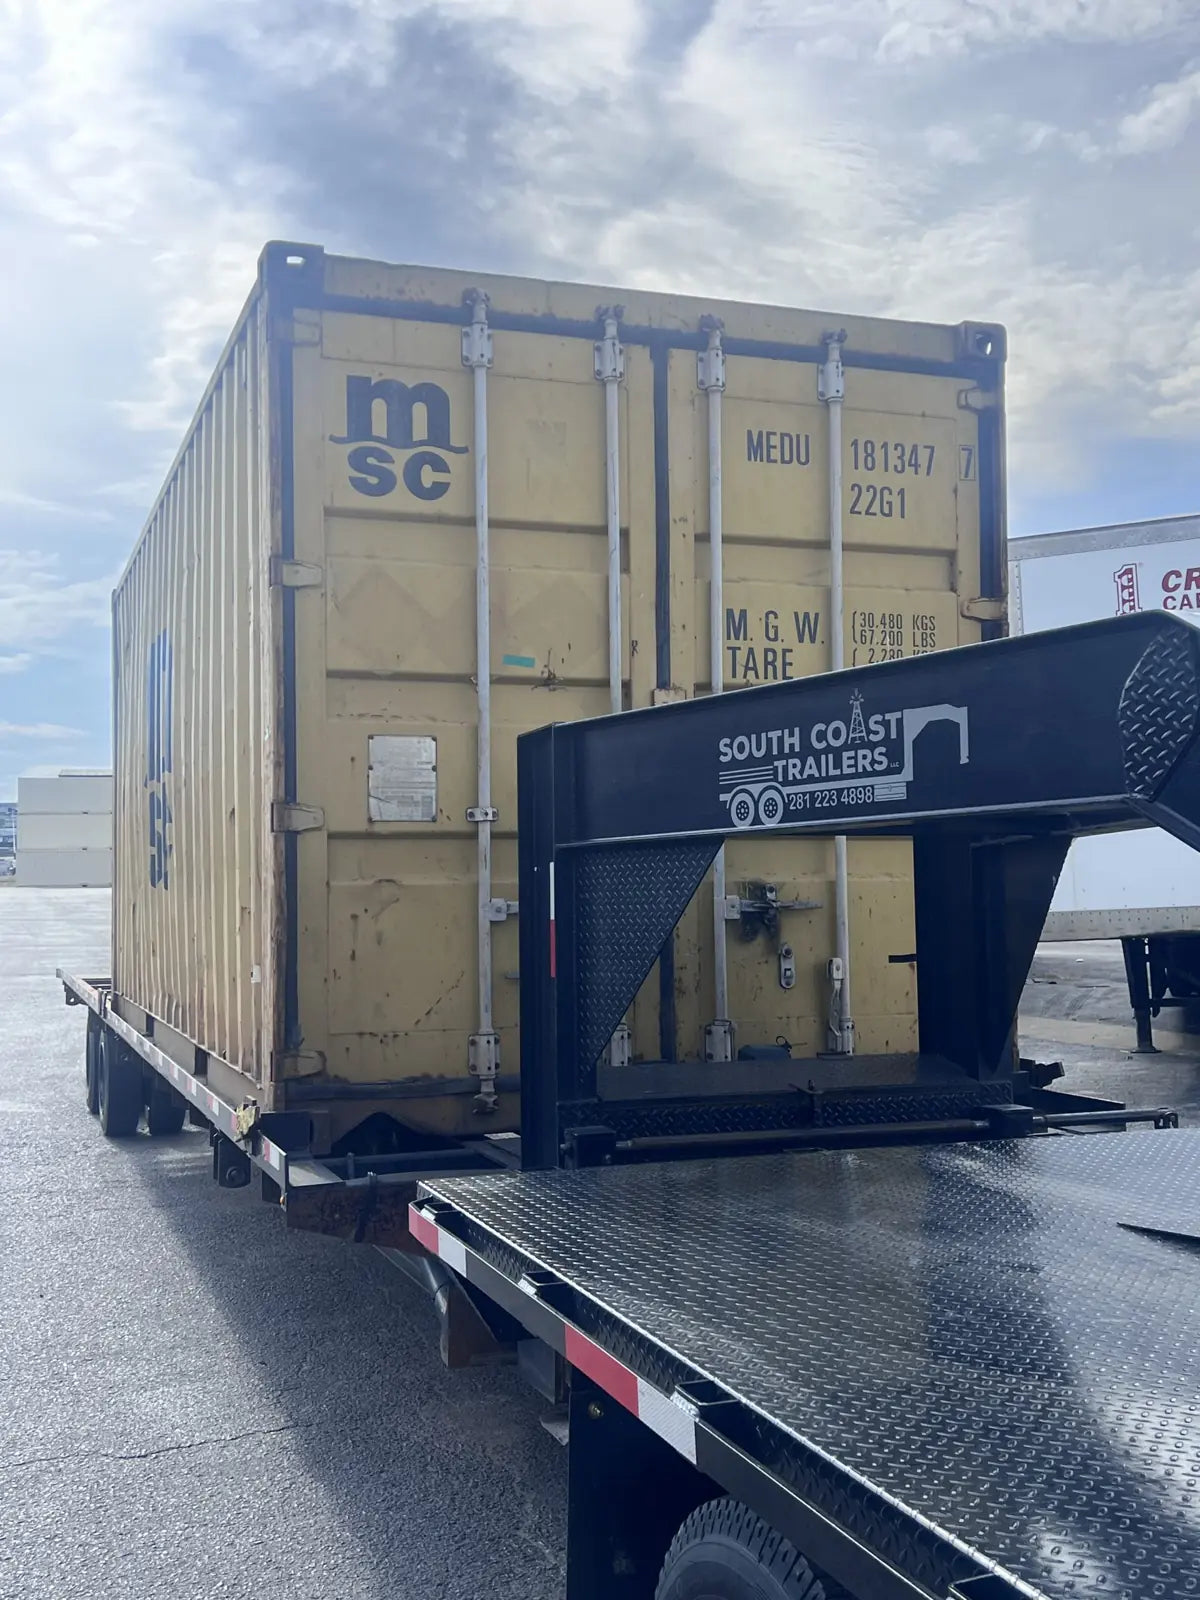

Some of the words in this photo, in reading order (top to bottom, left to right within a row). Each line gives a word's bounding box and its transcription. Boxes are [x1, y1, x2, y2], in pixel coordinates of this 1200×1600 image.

[746, 429, 811, 466] MEDU
[850, 438, 936, 477] 181347
[961, 447, 974, 479] 7
[849, 483, 906, 519] 22G1
[1161, 567, 1200, 593] CR
[912, 614, 936, 631] KGS
[912, 631, 936, 648] LBS
[726, 646, 794, 680] TARE
[719, 727, 800, 763] SOUTH
[810, 702, 902, 750] COAST
[773, 746, 889, 782] TRAILERS
[789, 793, 811, 810] 281
[815, 790, 838, 808] 223
[841, 786, 874, 804] 4898
